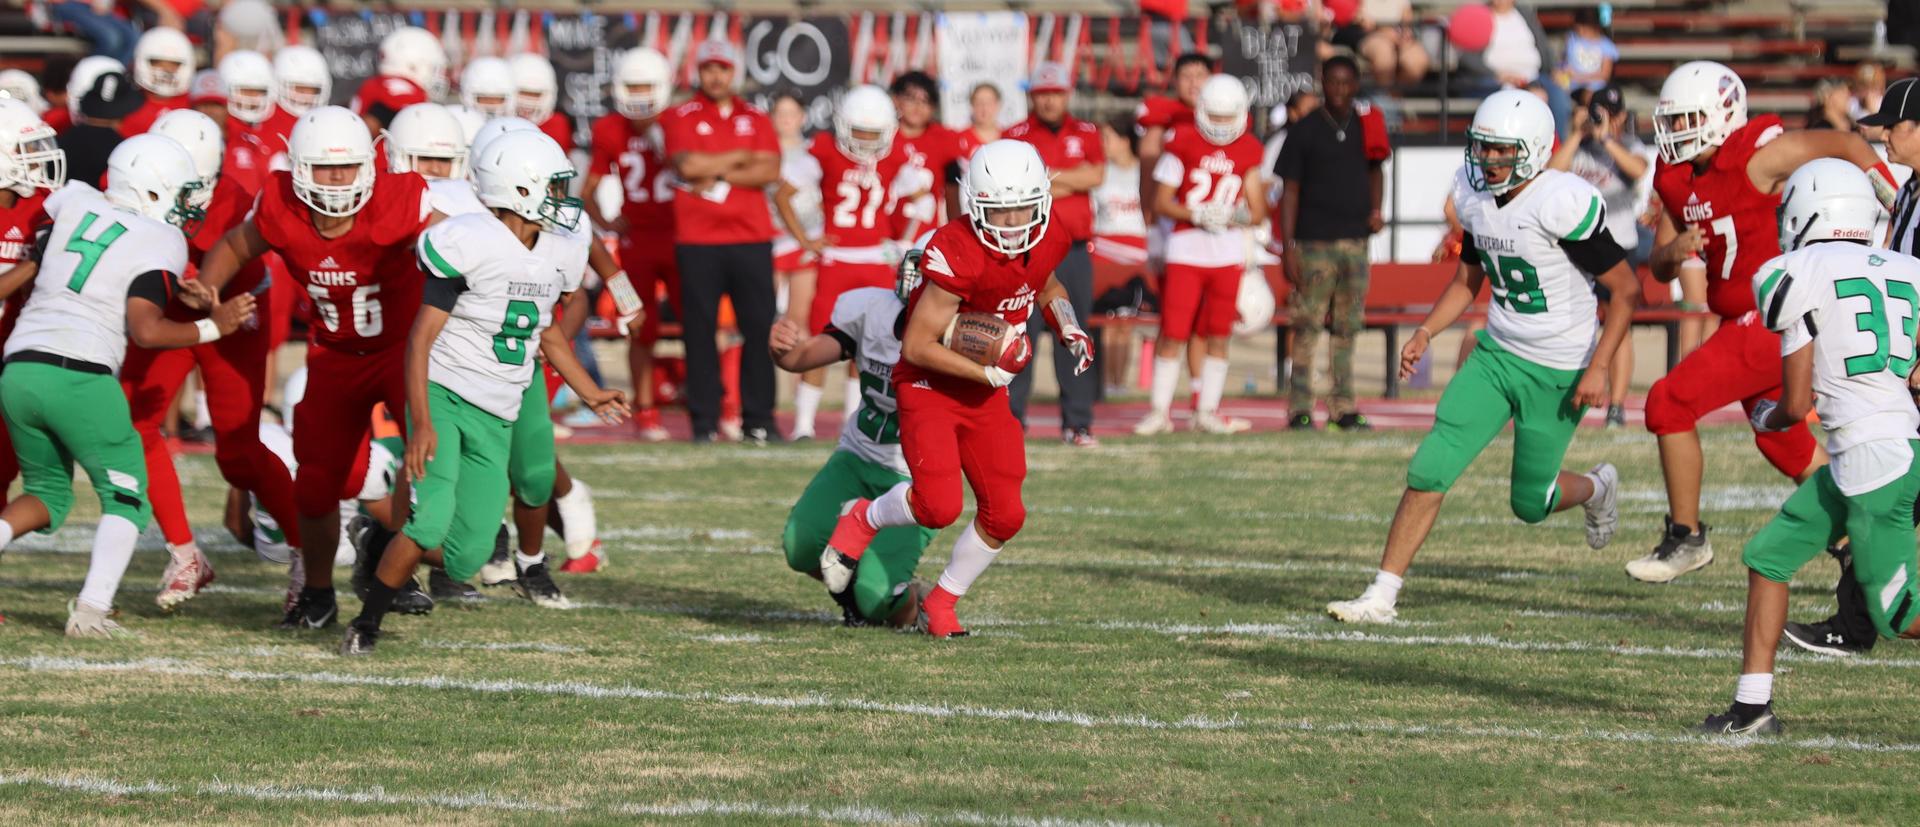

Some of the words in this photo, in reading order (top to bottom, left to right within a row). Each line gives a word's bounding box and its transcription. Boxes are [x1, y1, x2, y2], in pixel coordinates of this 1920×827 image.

[746, 20, 832, 86] GO
[1683, 201, 1713, 222] CUHS
[1475, 233, 1516, 253] RIVERDALE
[1833, 229, 1870, 238] Riddell
[0, 240, 32, 259] UHS
[64, 211, 129, 294] 4
[309, 270, 357, 287] CUHS
[507, 281, 552, 298] RIVERDALE
[307, 283, 383, 338] 56
[492, 299, 540, 367] 8
[1834, 276, 1920, 380] 33
